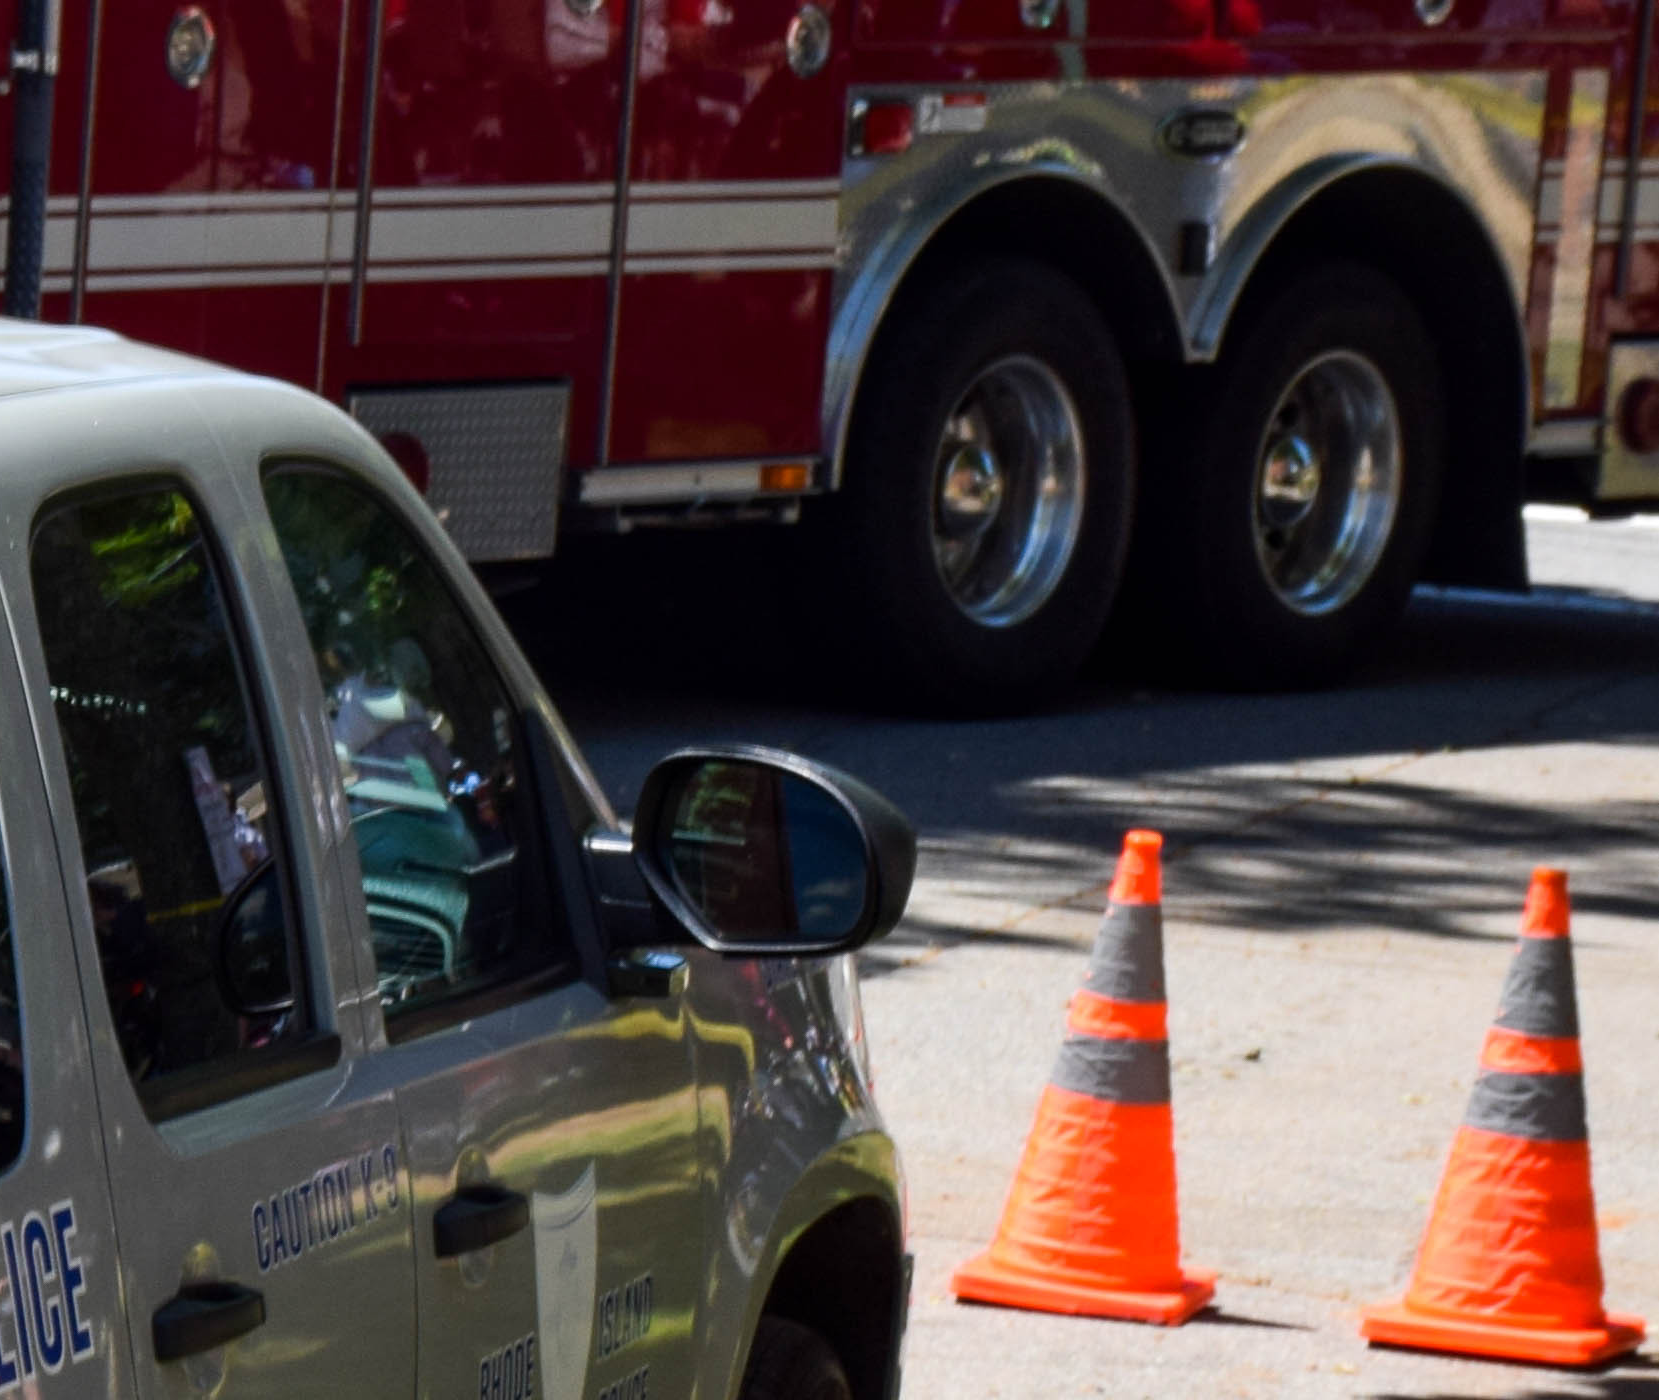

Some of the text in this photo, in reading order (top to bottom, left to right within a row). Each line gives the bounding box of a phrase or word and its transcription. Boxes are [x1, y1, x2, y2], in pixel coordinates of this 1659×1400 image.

[252, 1143, 400, 1274] CAUTION K-9
[596, 1270, 654, 1363] ISLAND
